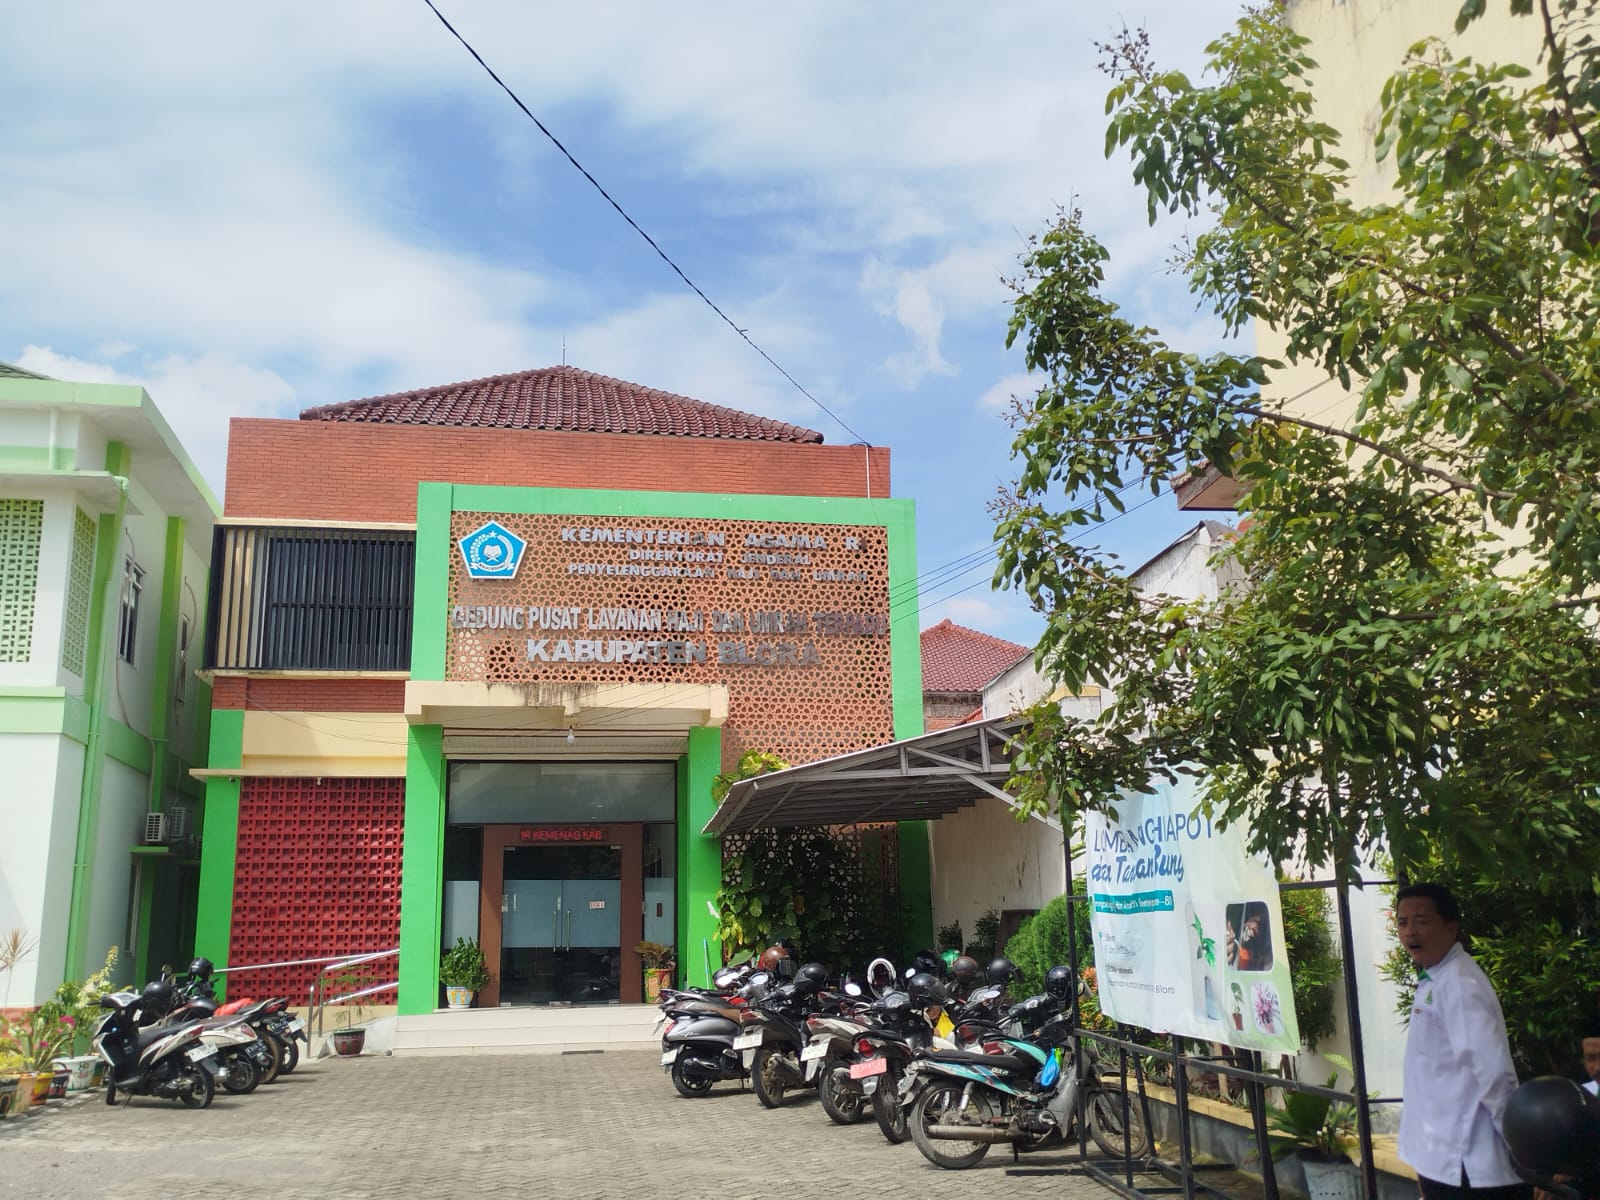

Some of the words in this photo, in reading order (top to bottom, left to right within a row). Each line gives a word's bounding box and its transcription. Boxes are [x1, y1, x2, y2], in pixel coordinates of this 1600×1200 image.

[561, 527, 725, 546] KEMENTERIAN
[744, 533, 827, 550] AGAMA
[629, 550, 724, 563] DIREKTORAT
[740, 554, 811, 565] JENDERAL
[569, 564, 716, 579] PENYELENGGARAAN
[726, 569, 760, 580] HAJI
[813, 571, 868, 583] UMRAH
[453, 605, 524, 630] GEDUNG
[528, 607, 581, 630] PUSAT
[588, 608, 661, 632] LAYANAN
[667, 610, 704, 632] HAJI
[712, 611, 744, 632] DAN
[750, 612, 809, 634] UMRAH
[527, 639, 707, 664] KABUPATEN
[718, 641, 822, 666] BLORA
[532, 829, 581, 840] KEMENAG
